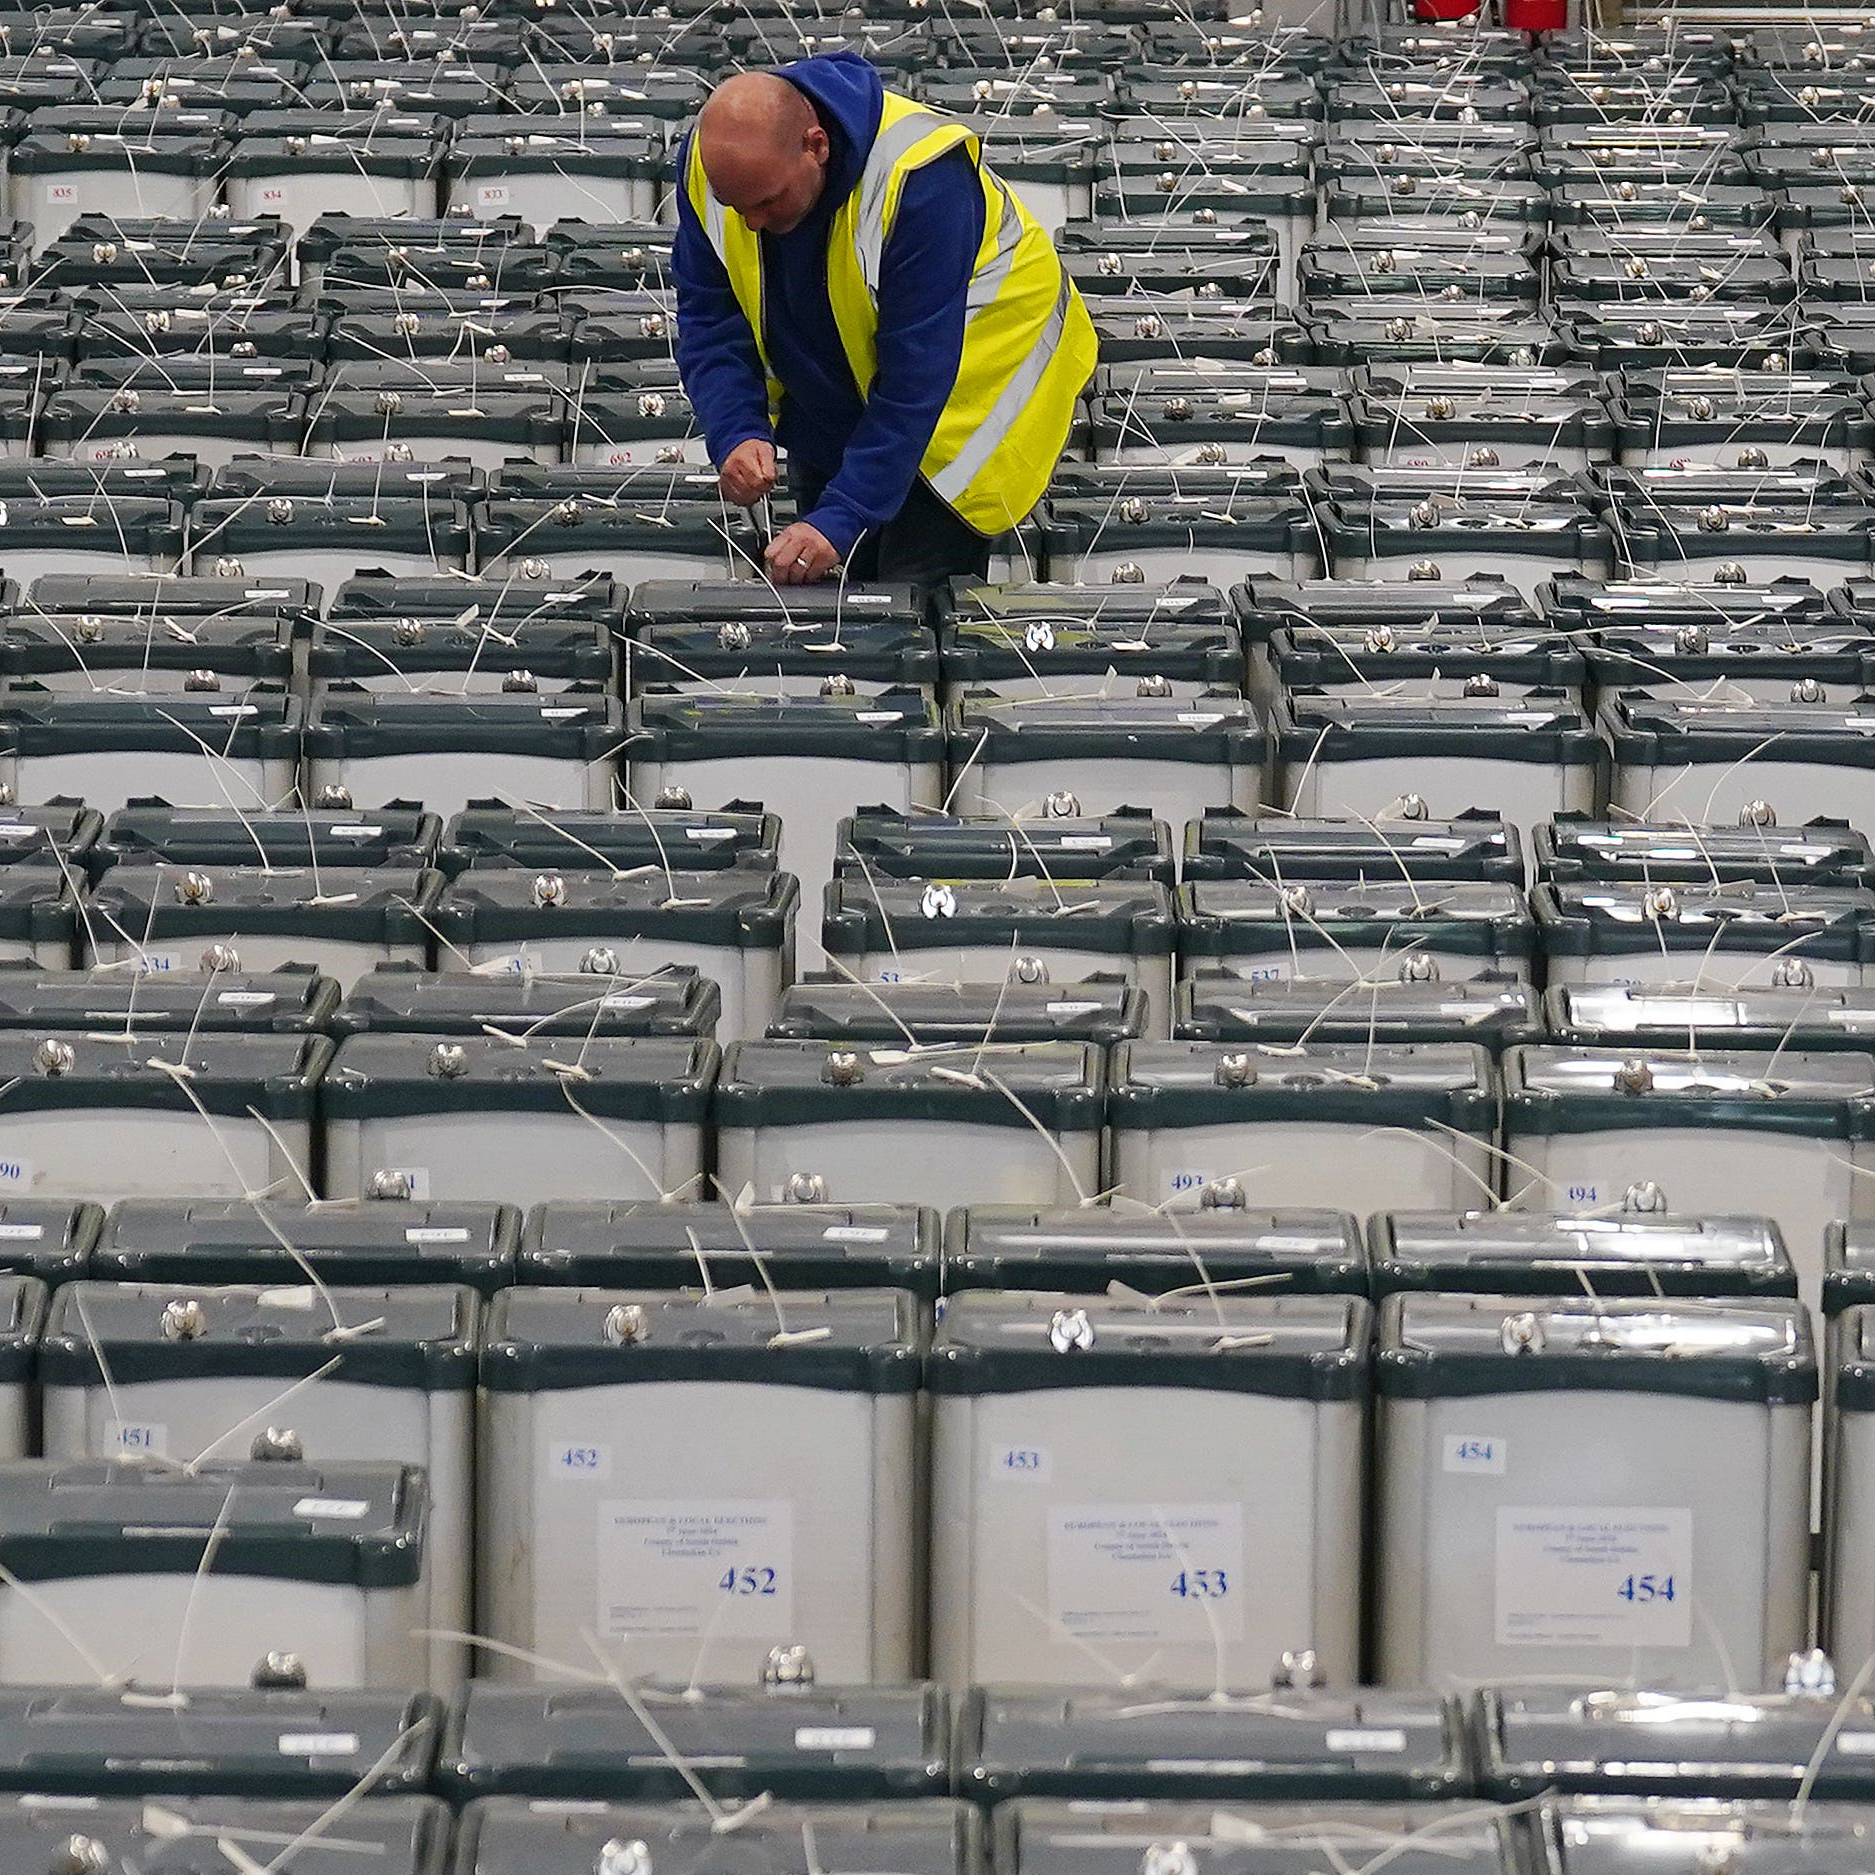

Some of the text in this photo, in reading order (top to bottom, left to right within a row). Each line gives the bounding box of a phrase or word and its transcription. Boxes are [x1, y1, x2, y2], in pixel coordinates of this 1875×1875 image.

[561, 1448, 598, 1469] 452
[1005, 1450, 1040, 1470] 453
[1457, 1441, 1494, 1462] 454
[718, 1566, 777, 1596] 452
[1170, 1569, 1229, 1599] 453
[1617, 1574, 1676, 1603] 454
